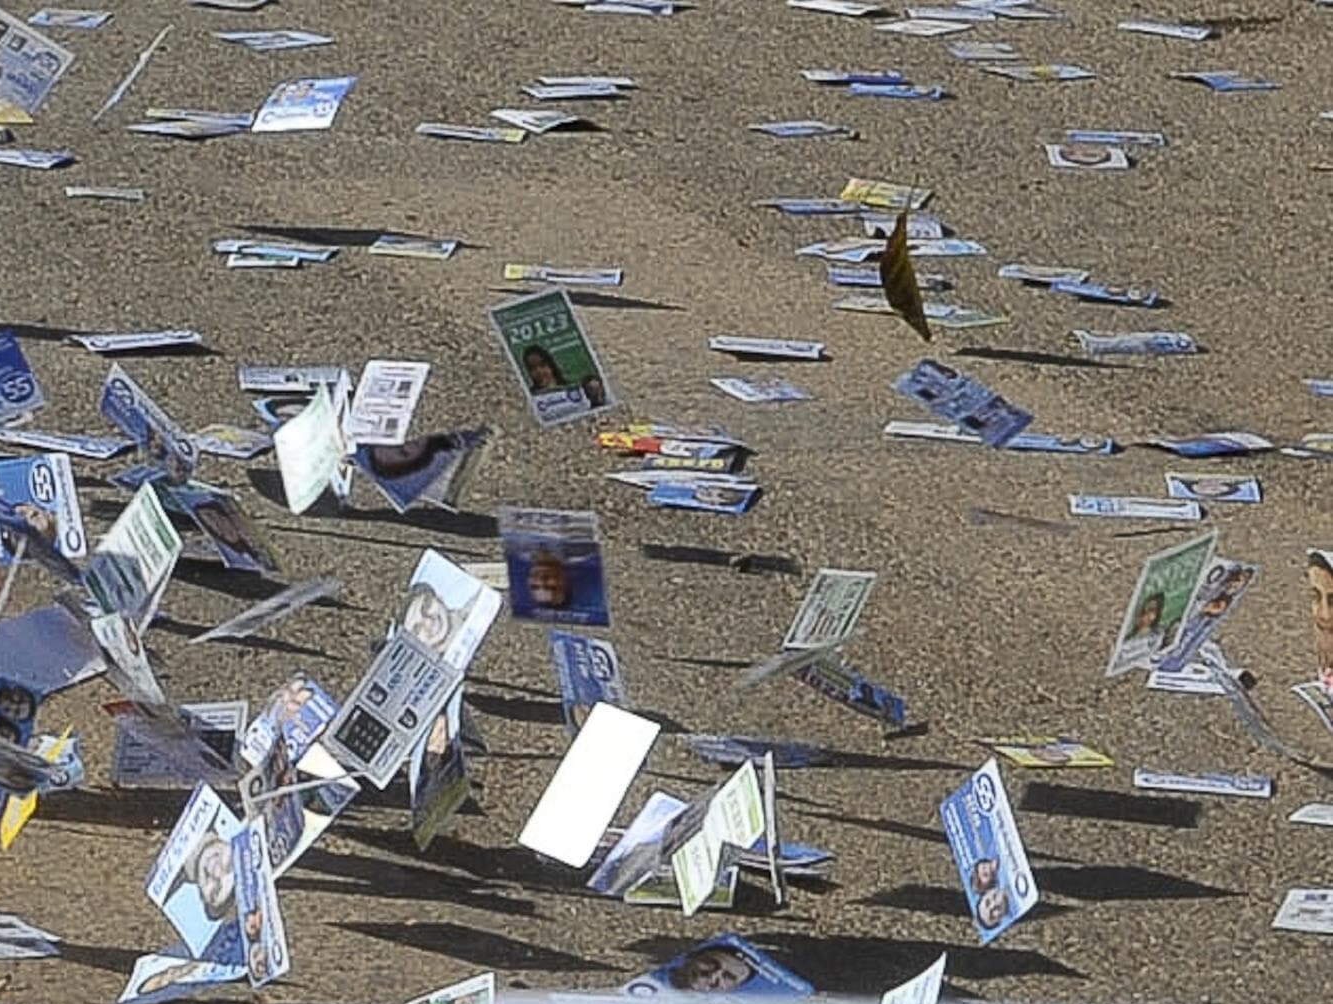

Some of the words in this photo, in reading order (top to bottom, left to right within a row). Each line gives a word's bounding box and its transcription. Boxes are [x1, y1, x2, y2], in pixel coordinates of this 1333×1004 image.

[507, 312, 567, 344] 20123
[2, 377, 32, 399] 55
[34, 466, 51, 499] 55
